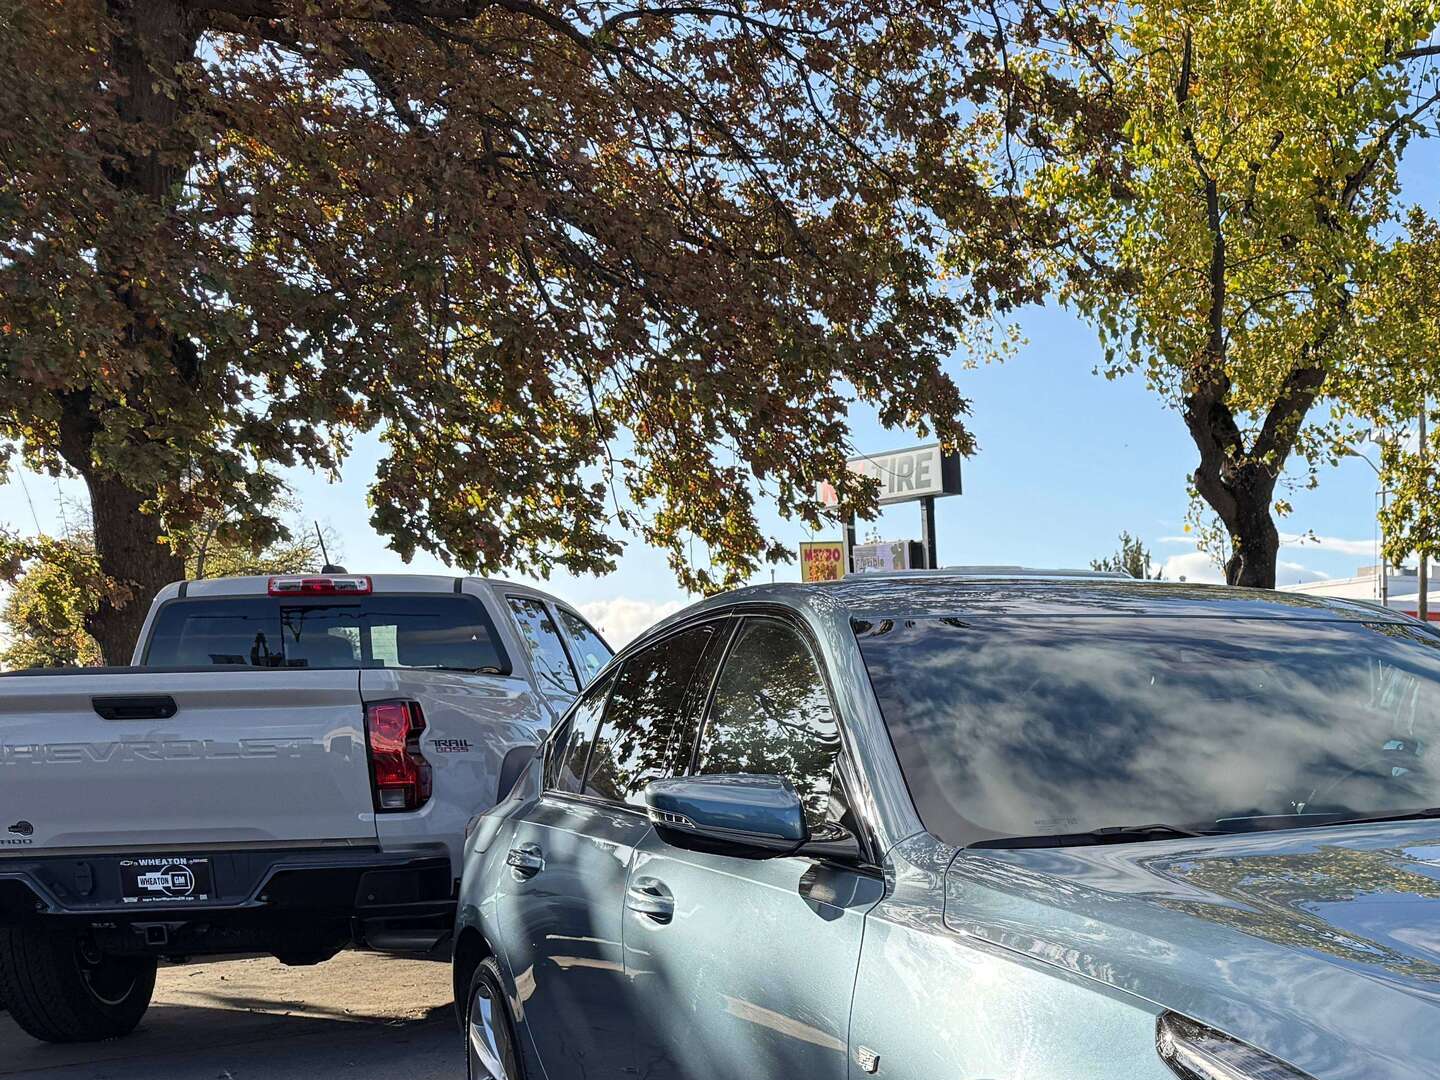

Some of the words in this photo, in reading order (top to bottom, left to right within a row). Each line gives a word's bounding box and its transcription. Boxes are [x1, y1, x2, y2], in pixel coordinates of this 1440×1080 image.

[872, 452, 934, 493] TIRE
[429, 739, 474, 747] TRAIL
[0, 737, 313, 766] HEVROLET
[138, 857, 187, 866] WHEATON
[139, 876, 170, 887] WHEATON
